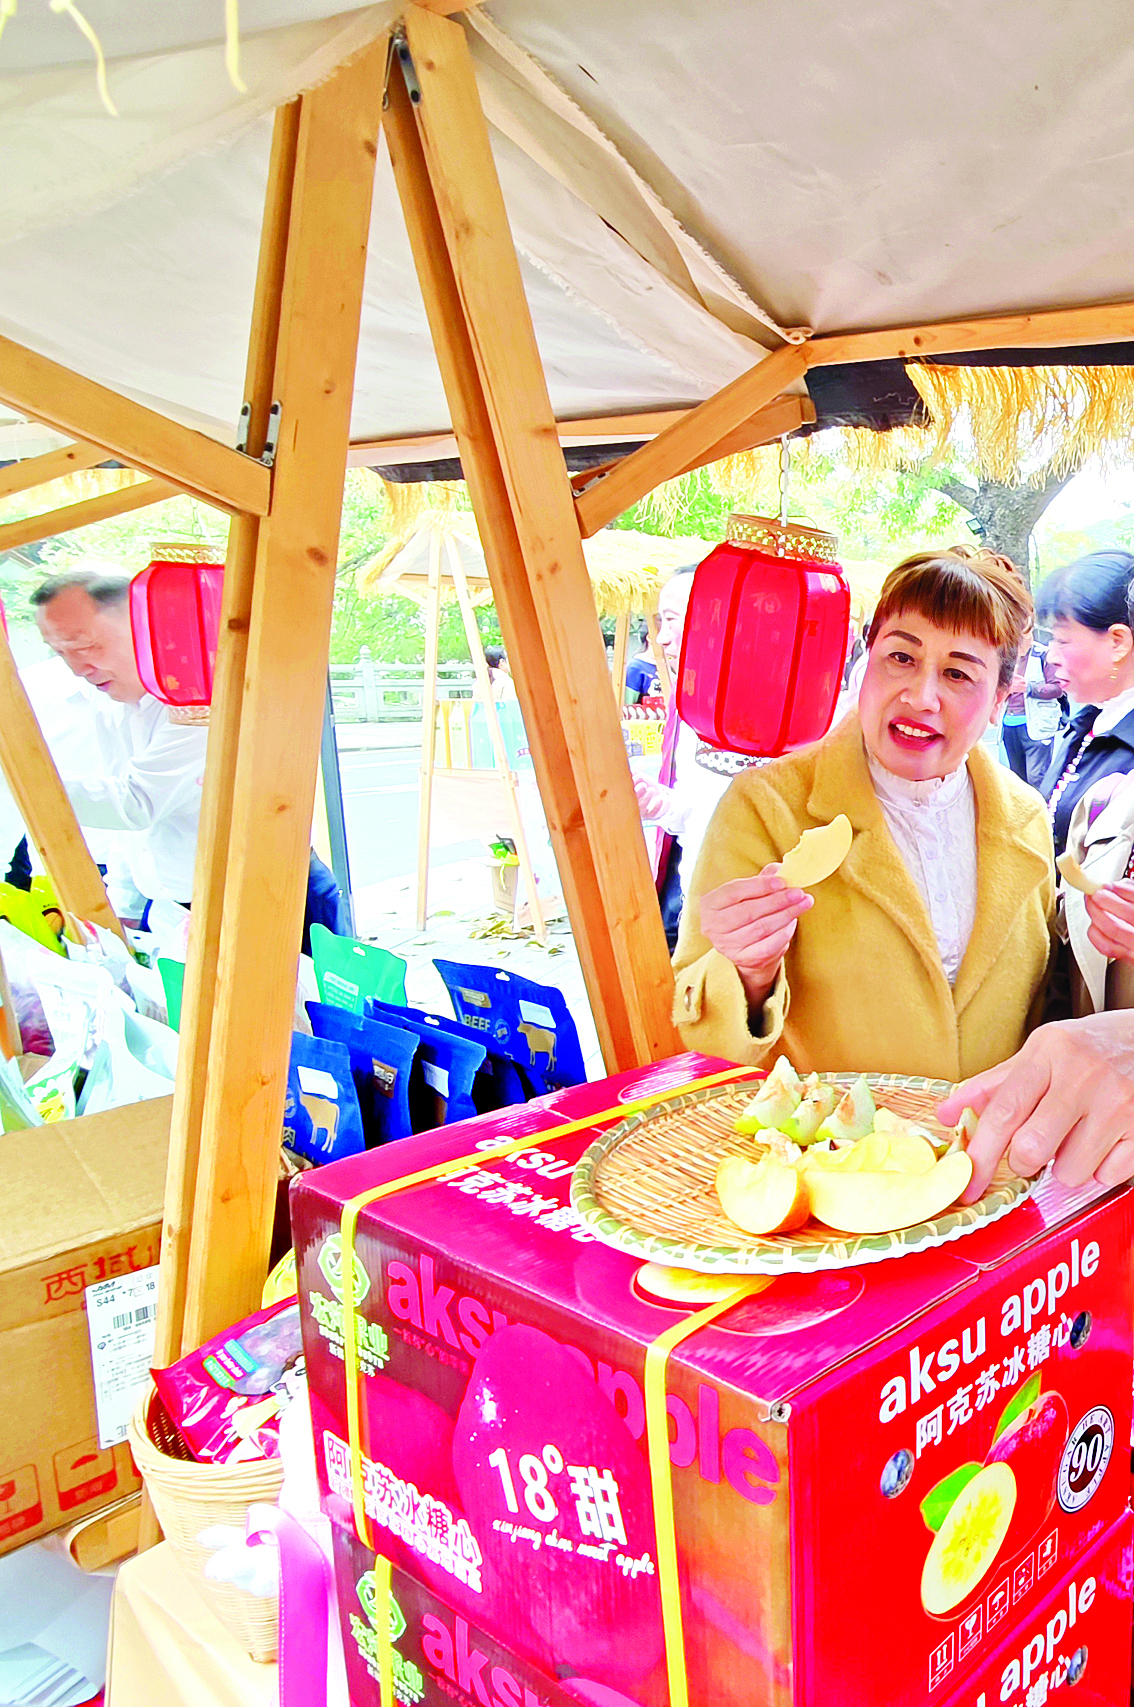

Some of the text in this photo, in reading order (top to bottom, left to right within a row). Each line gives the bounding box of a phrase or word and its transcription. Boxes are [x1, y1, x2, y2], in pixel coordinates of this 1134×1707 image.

[464, 1014, 491, 1032] BEEF
[387, 1253, 507, 1359] aks
[879, 1238, 1100, 1424] aksu apple
[915, 1312, 1074, 1459] 阿克苏冰糖心
[1069, 1433, 1103, 1483] 90
[615, 1552, 655, 1579] apple
[1000, 1576, 1096, 1702] apple
